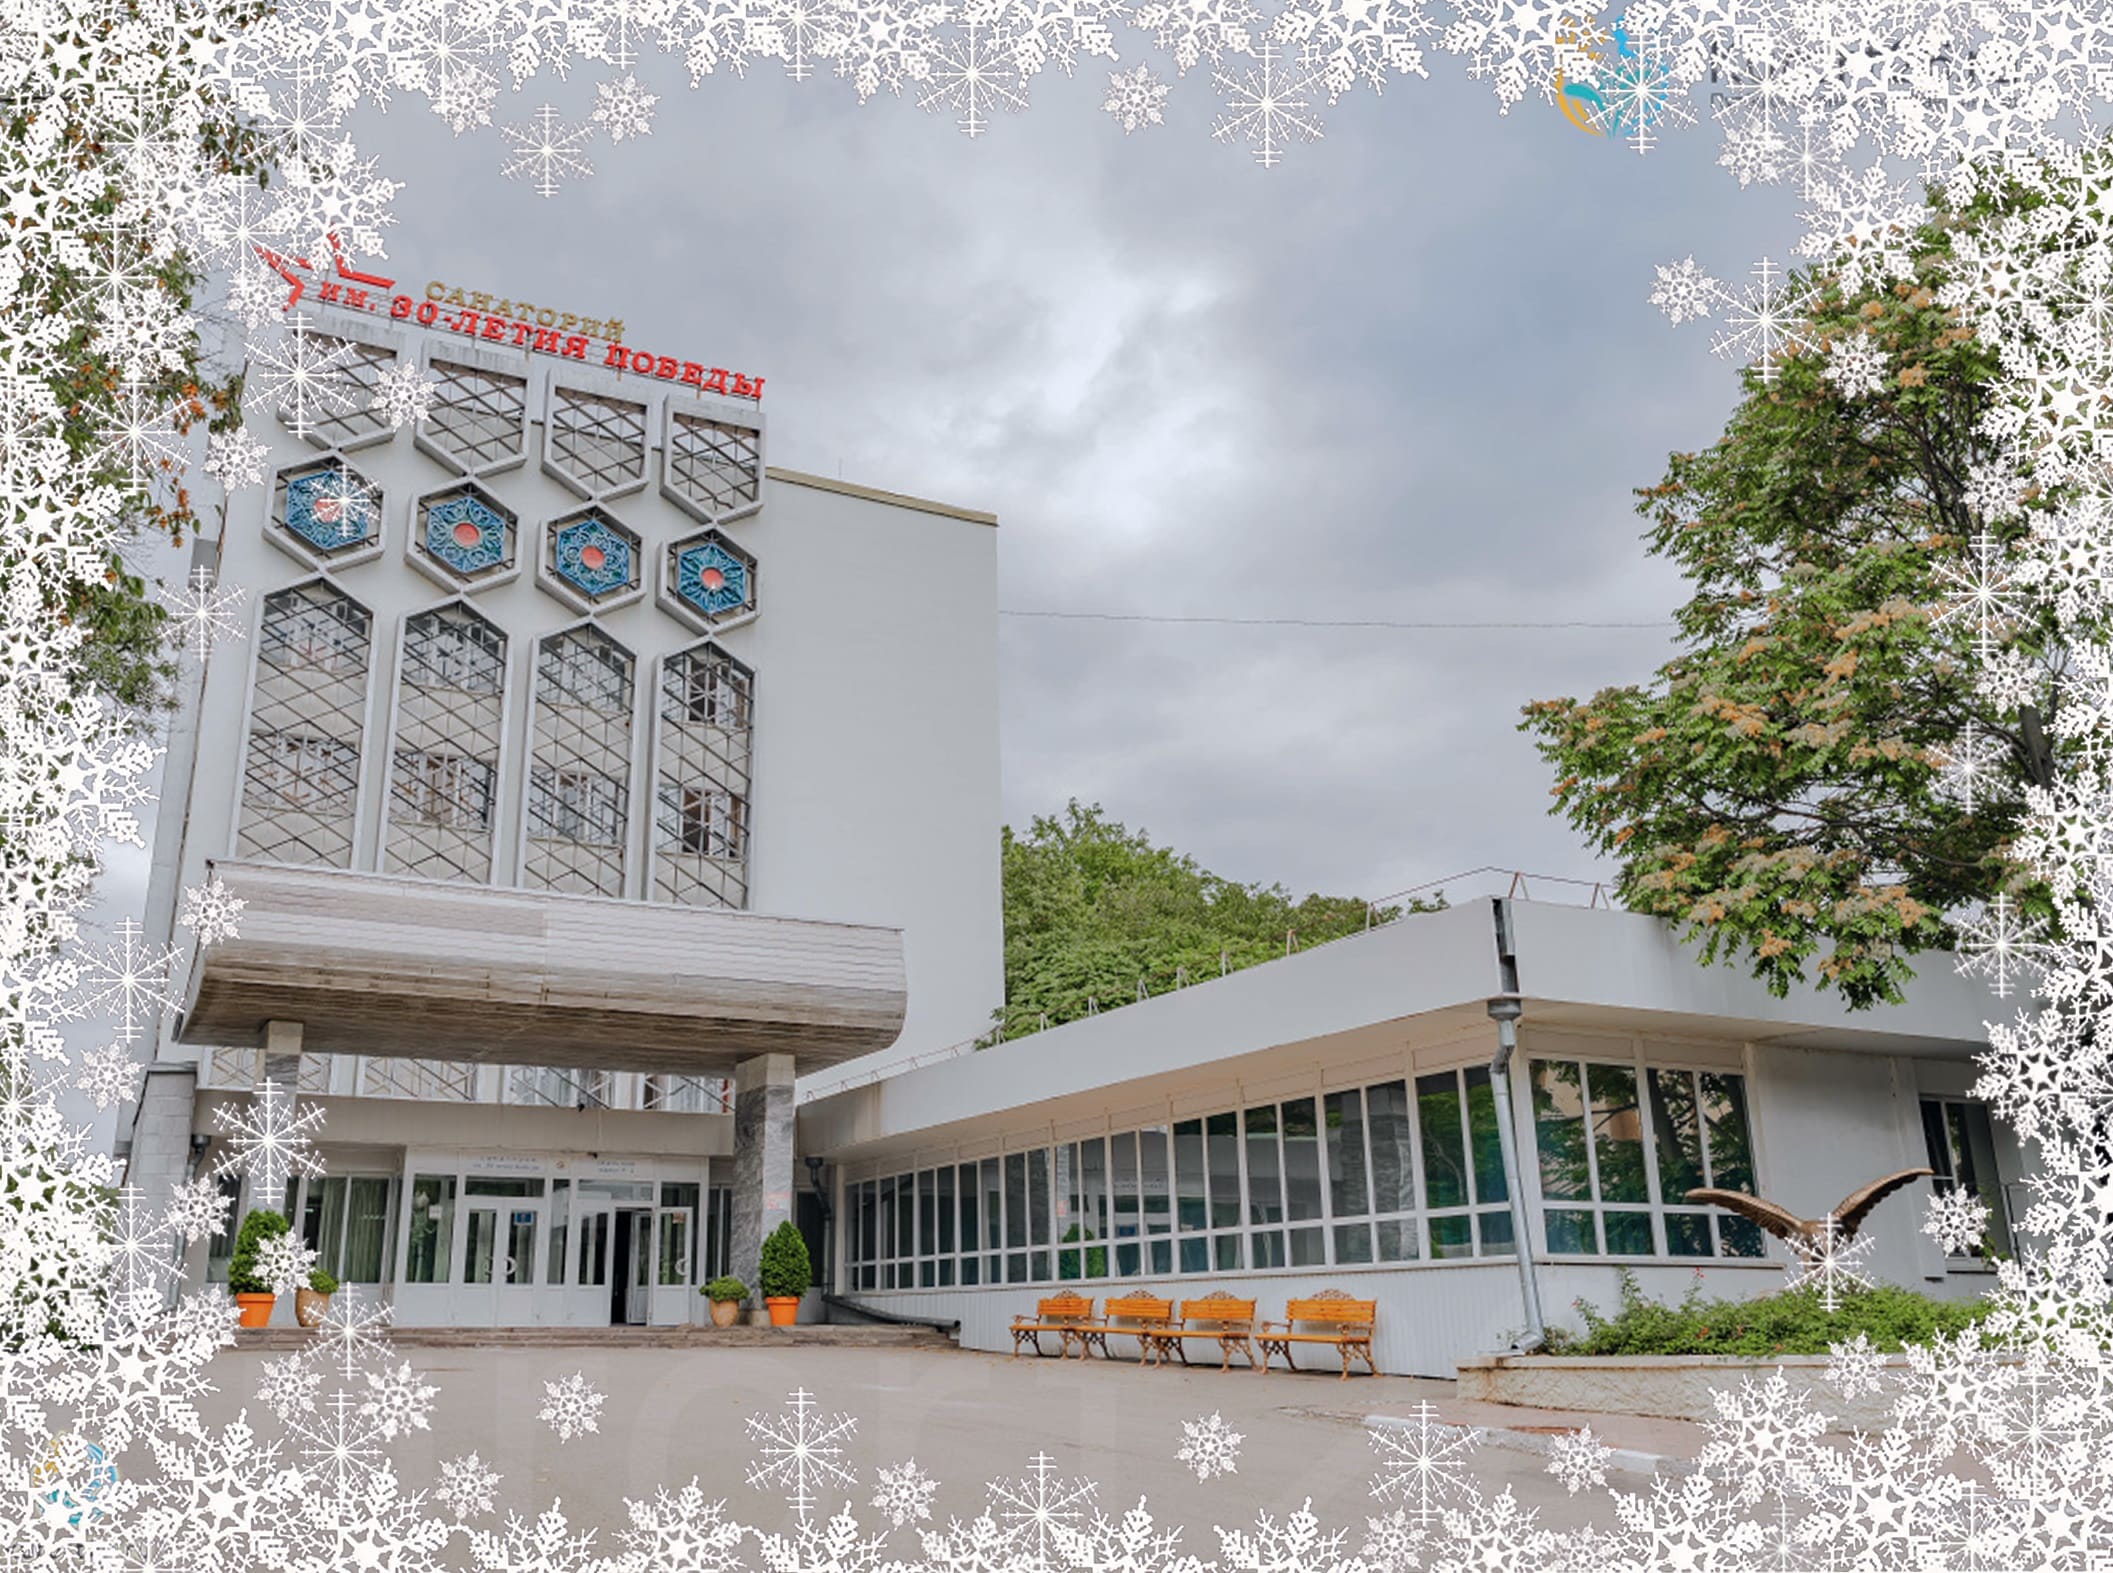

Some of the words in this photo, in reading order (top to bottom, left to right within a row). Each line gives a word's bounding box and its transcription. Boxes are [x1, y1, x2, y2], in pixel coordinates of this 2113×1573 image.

[389, 294, 590, 360] 30-ЛЕТИЯ
[603, 343, 766, 399] ПОБЕДЫ
[425, 281, 625, 344] САНАТОРИЙ
